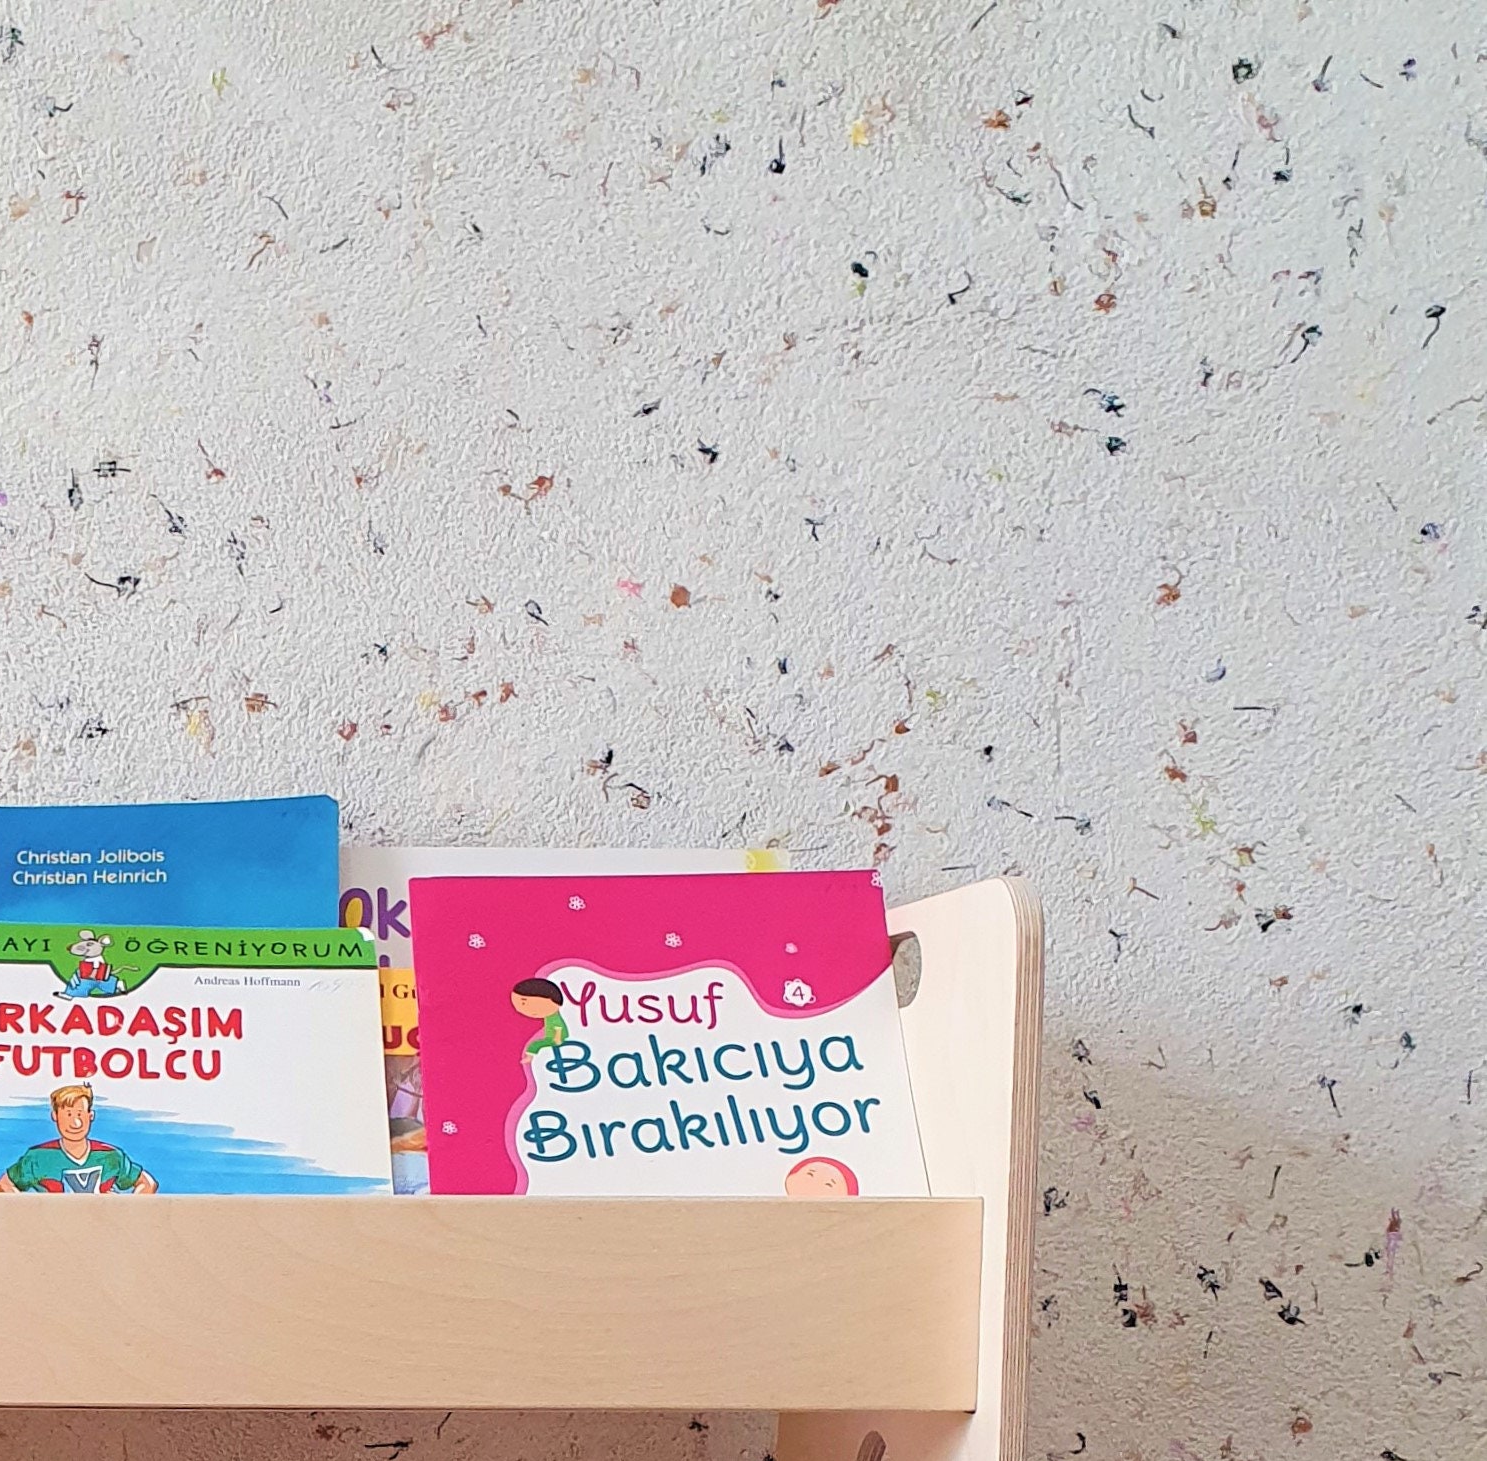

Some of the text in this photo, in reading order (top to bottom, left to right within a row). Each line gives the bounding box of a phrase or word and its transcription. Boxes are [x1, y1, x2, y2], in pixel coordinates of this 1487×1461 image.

[16, 850, 92, 865] Christian
[13, 868, 168, 885] Christian Heinrich
[124, 936, 364, 958] ÖĞRENİYORUM
[194, 976, 241, 987] Andreas
[244, 976, 302, 988] Hoffmann
[791, 986, 805, 1001] 4
[560, 981, 725, 1030] Yusuf
[545, 1034, 865, 1094] Bakıcıya
[523, 1094, 881, 1164] Bırakılıyor
